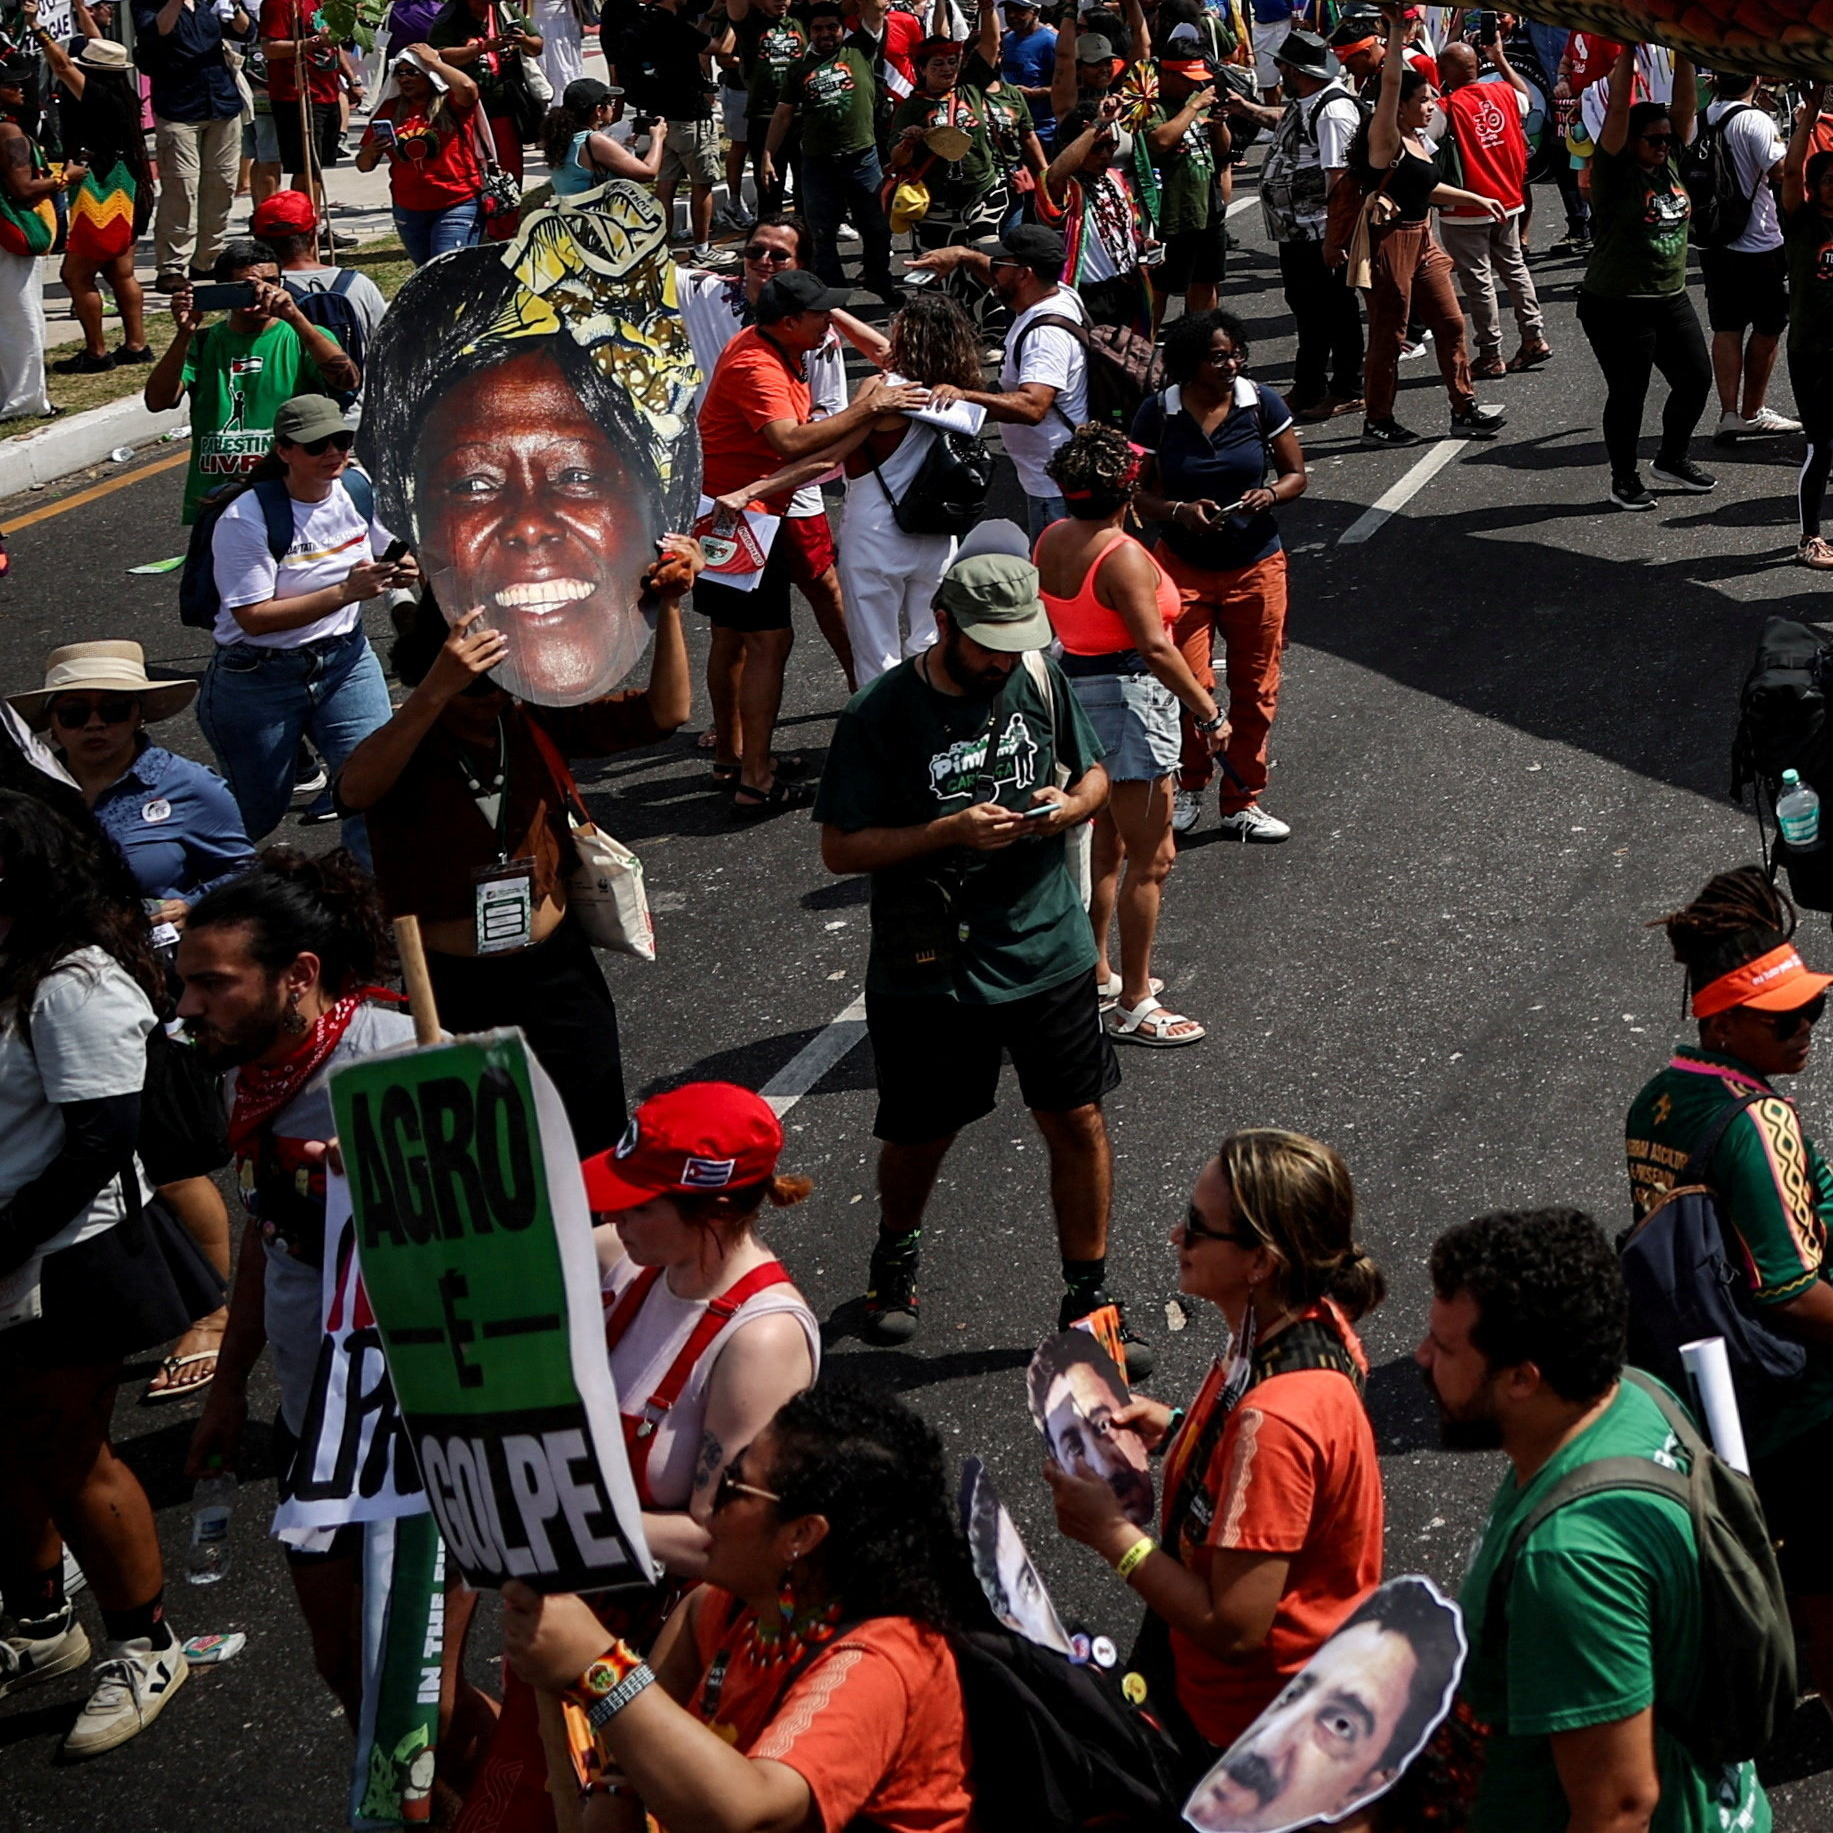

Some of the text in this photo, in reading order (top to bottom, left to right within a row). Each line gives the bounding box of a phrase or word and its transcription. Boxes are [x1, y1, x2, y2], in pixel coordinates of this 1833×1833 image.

[201, 436, 275, 456] PALESTIN
[351, 1065, 540, 1249] AGRO
[436, 1269, 487, 1390] É
[421, 1427, 628, 1577] GOLPE
[422, 1592, 446, 1660] THE
[416, 1667, 443, 1704] IN
